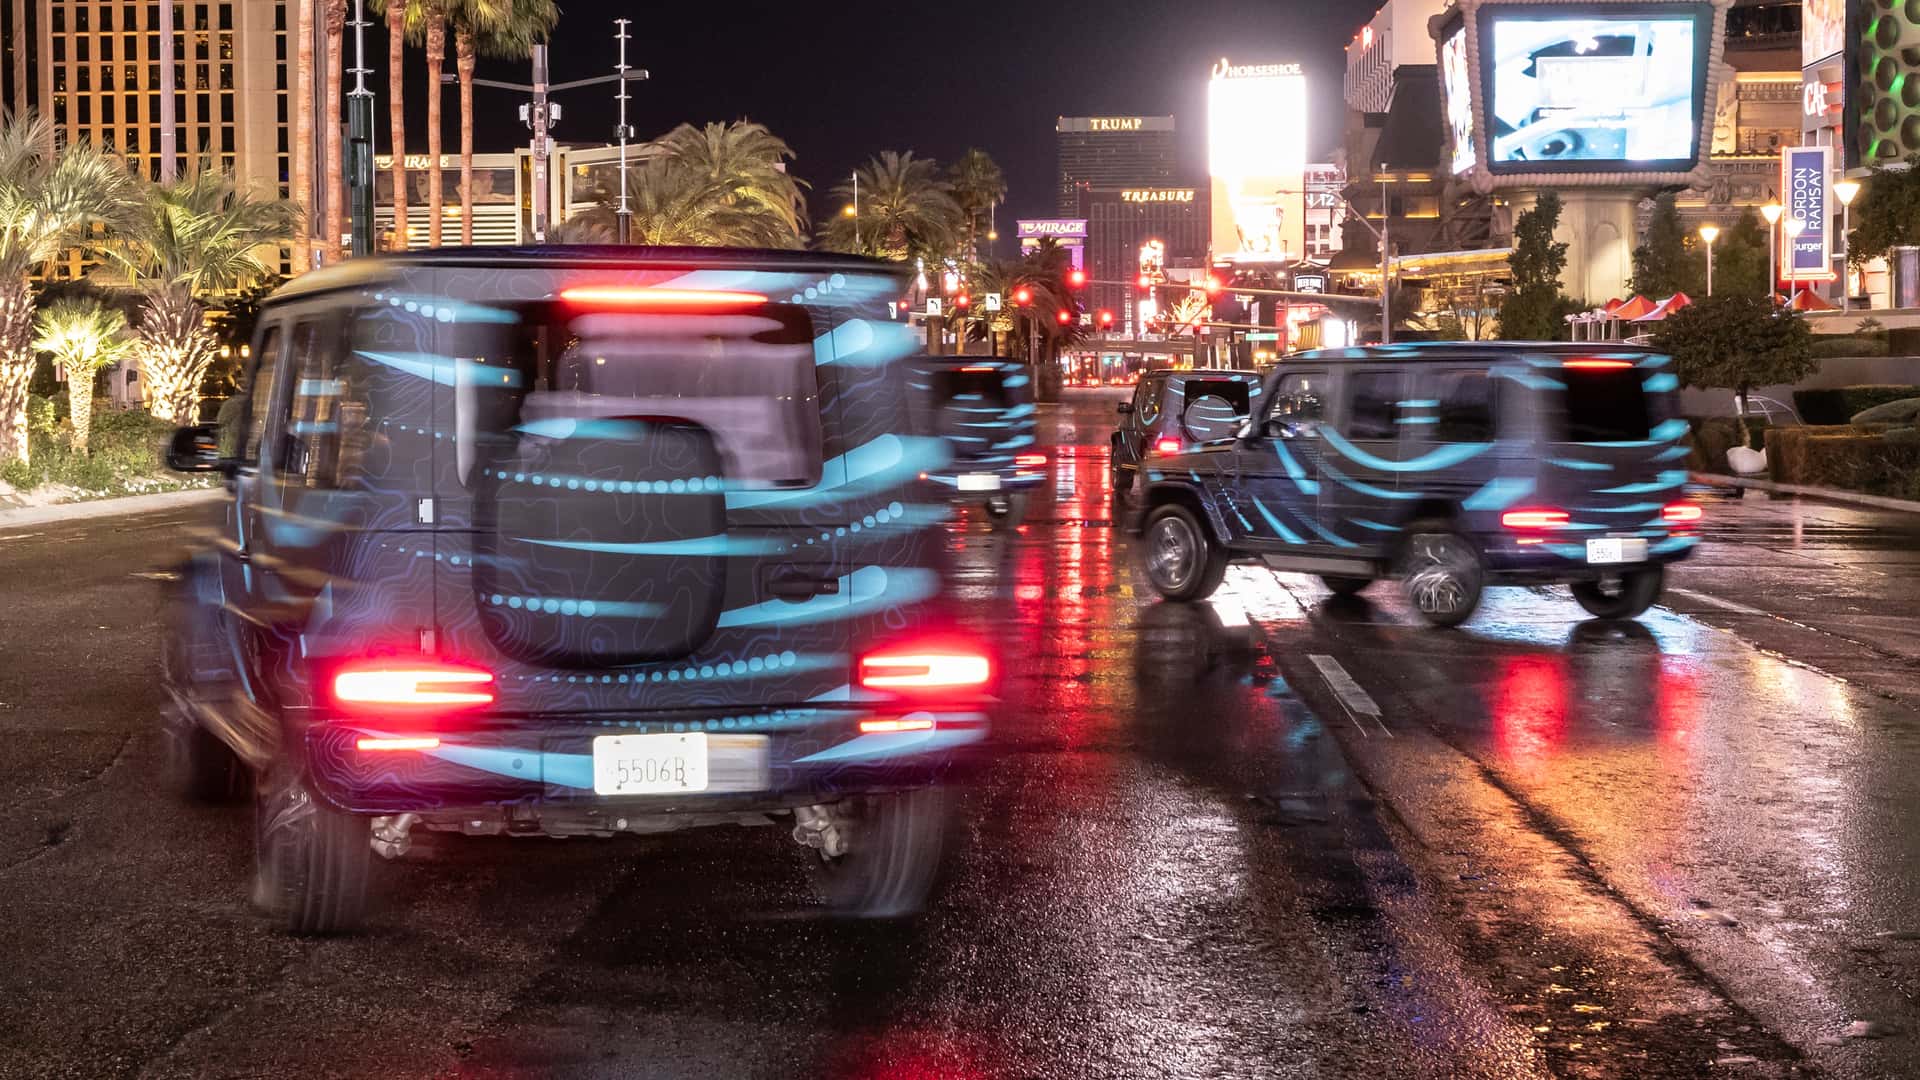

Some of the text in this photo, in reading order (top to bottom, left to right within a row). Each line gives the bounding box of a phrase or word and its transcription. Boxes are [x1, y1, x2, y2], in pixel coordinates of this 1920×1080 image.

[1227, 64, 1302, 77] HORSESHOE
[1091, 119, 1142, 130] TRUMP
[380, 155, 449, 169] IRAE
[1121, 191, 1194, 202] TREASURE
[1793, 168, 1807, 226] ORDON
[1808, 168, 1821, 230] RAMSAY
[1025, 222, 1083, 234] MIRAGE
